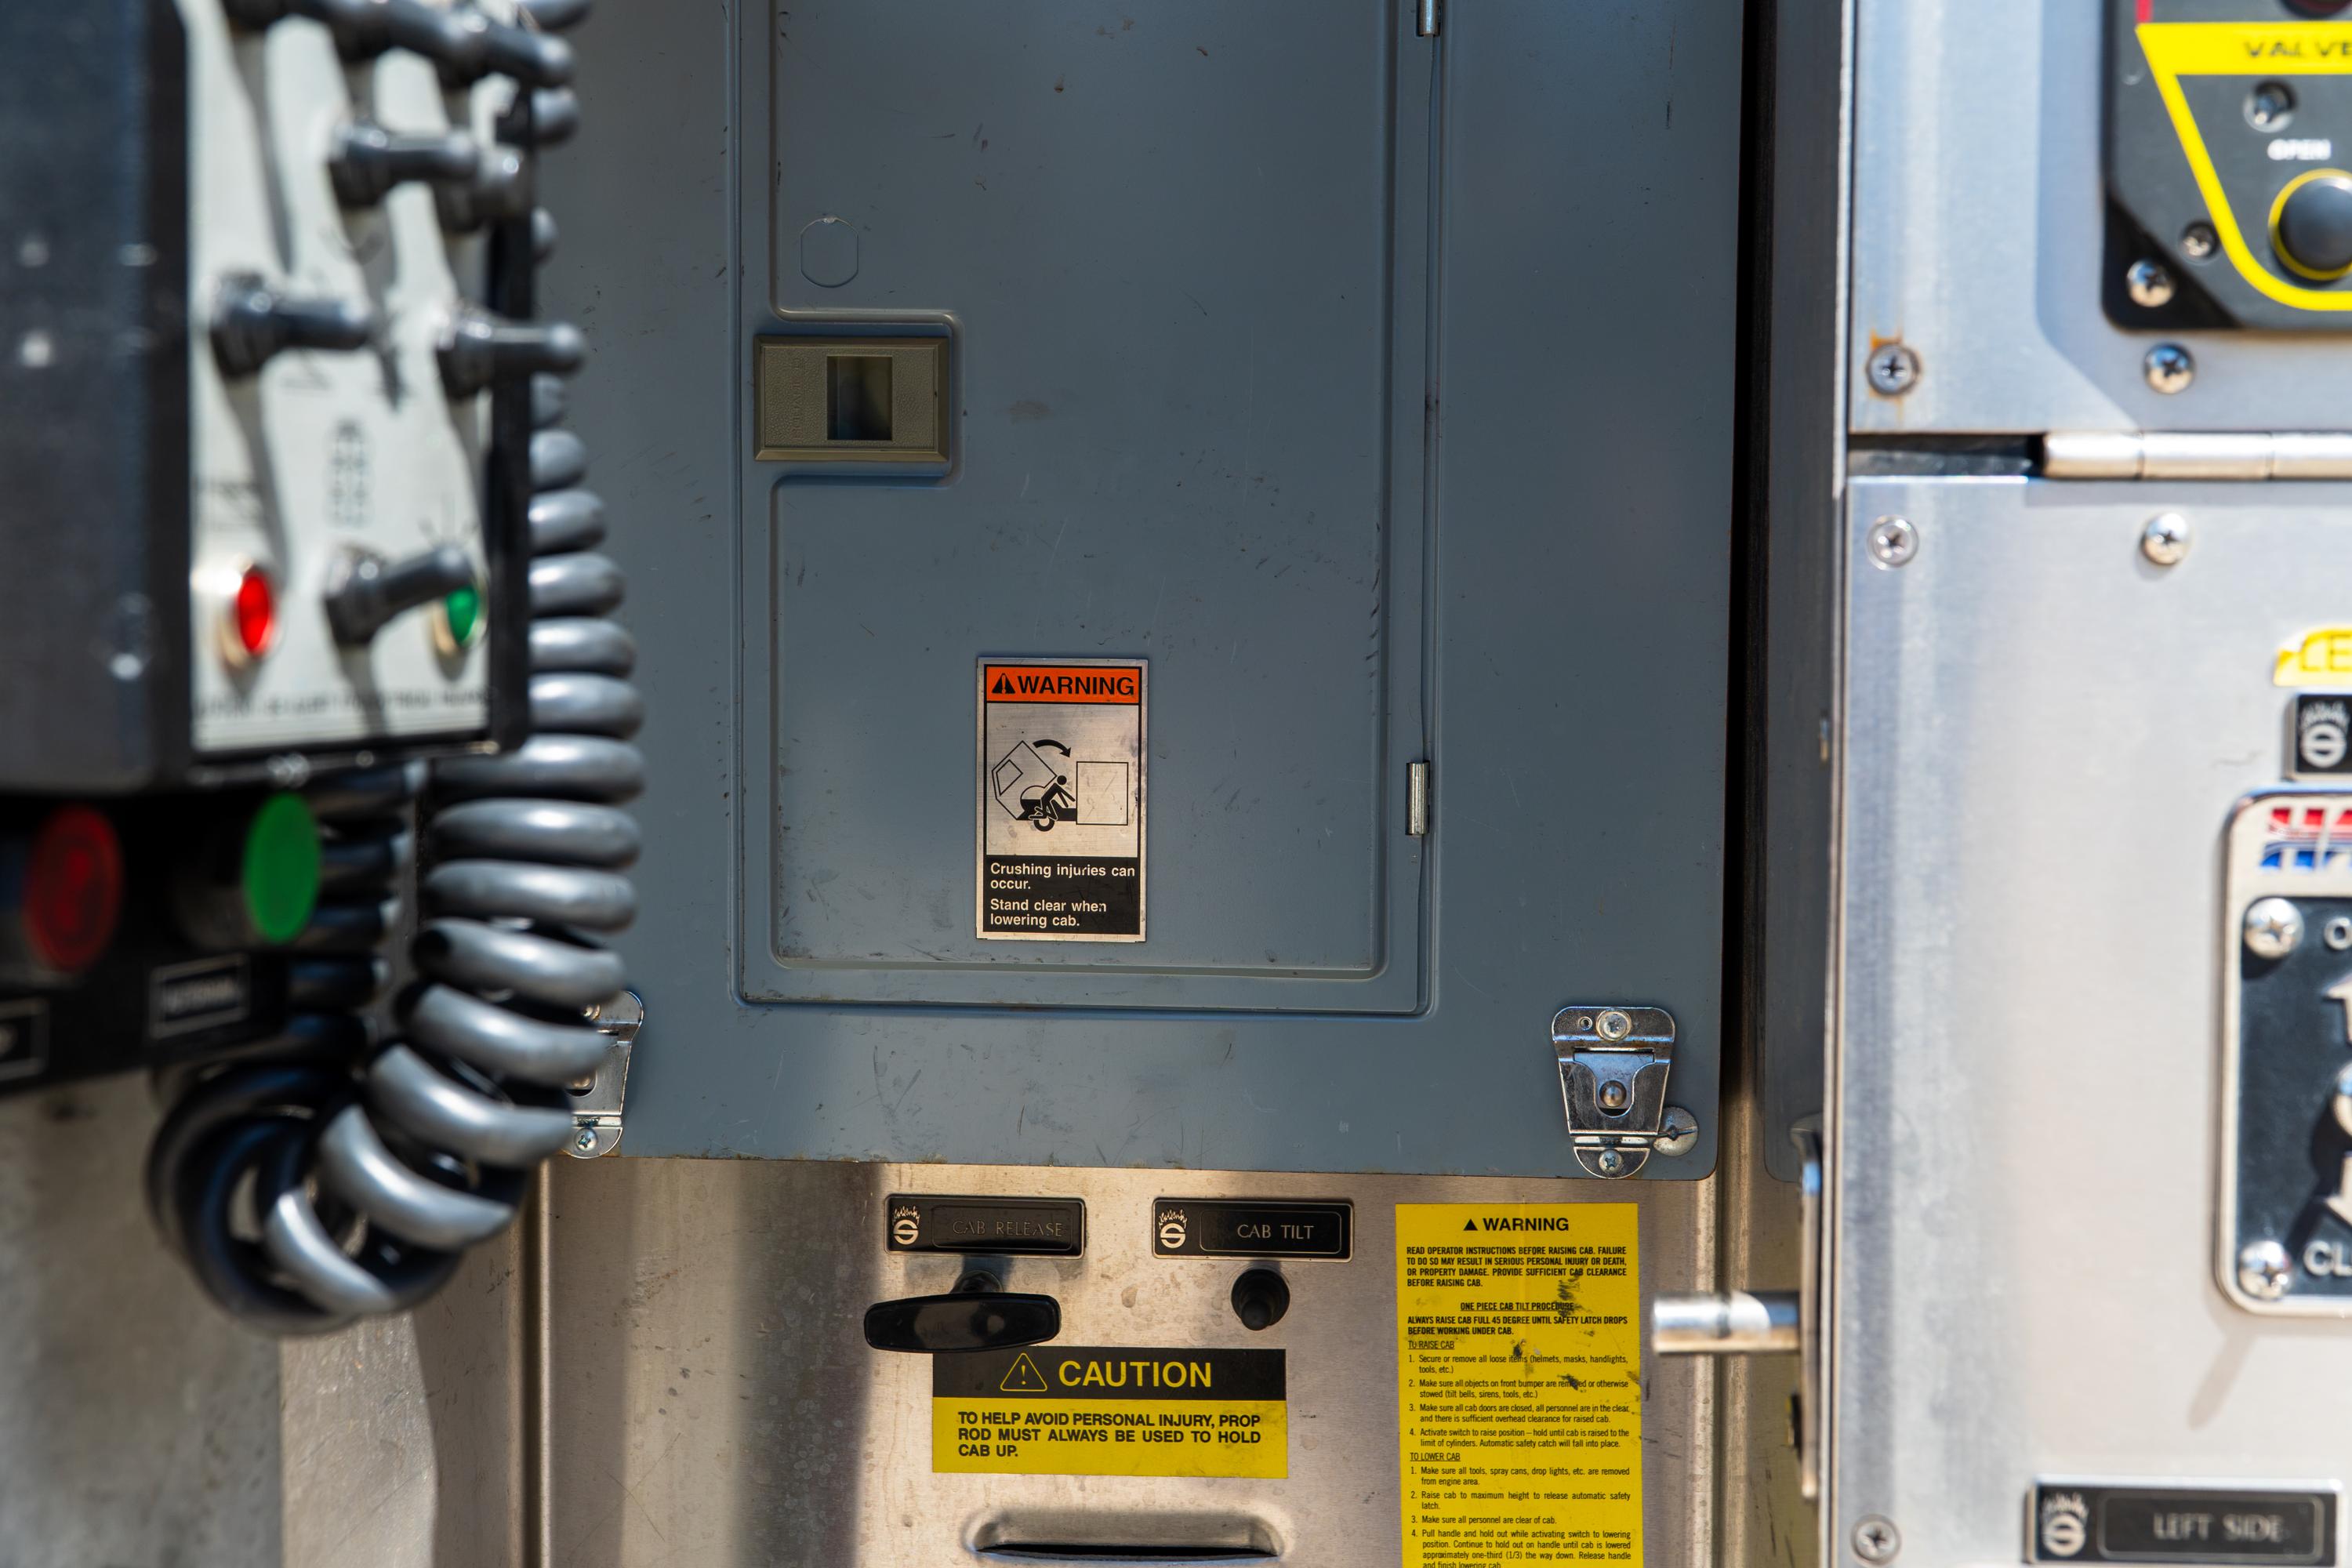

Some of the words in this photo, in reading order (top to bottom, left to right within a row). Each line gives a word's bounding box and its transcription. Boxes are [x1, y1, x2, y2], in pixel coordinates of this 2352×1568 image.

[1017, 675, 1134, 696] WARNING
[990, 862, 1052, 878] Crushing
[1057, 863, 1106, 878] injuries
[1111, 866, 1135, 877] can
[990, 880, 1031, 889] occur.
[990, 898, 1029, 911] Stand
[1034, 899, 1066, 911] clear
[1071, 901, 1107, 912] when
[990, 913, 1047, 928] lowering
[1052, 915, 1080, 926] cab.
[953, 1220, 985, 1235] CAB
[996, 1221, 1063, 1237] RELEASE
[1483, 1218, 1570, 1231] WARNING
[1236, 1224, 1272, 1239] CAB
[1280, 1225, 1315, 1240] TILT
[1602, 1258, 1627, 1266] DEATH,
[1408, 1327, 1436, 1335] BEFORE
[1436, 1327, 1470, 1335] WORKING
[1472, 1327, 1496, 1335] UNDER
[1497, 1327, 1514, 1335] CAB.
[1419, 1355, 1442, 1363] Secure
[1479, 1355, 1487, 1363] all
[1490, 1355, 1507, 1363] loose
[1530, 1355, 1562, 1365] (helmets,
[1563, 1355, 1588, 1364] masks,
[1590, 1355, 1628, 1365] handlights,
[1058, 1360, 1212, 1388] CAUTION
[1445, 1390, 1457, 1399] (tilt
[1459, 1390, 1477, 1399] bells,
[1479, 1390, 1501, 1399] sirens,
[1502, 1390, 1521, 1399] tools,
[1523, 1390, 1538, 1399] etc.)
[958, 1412, 978, 1425] TO
[982, 1412, 1021, 1425] HELP
[1024, 1413, 1069, 1426] AVOID
[1073, 1414, 1155, 1427] PERSONAL
[1159, 1414, 1215, 1429] INJURY,
[1219, 1414, 1261, 1428] PROP
[958, 1428, 991, 1441] ROD
[998, 1428, 1040, 1441] MUST
[1047, 1428, 1109, 1442] ALWAYS
[1115, 1429, 1136, 1442] BE
[1142, 1429, 1184, 1443] USED
[1192, 1430, 1209, 1443] TO
[1218, 1430, 1261, 1443] HOLD
[958, 1443, 990, 1457] CAB
[996, 1444, 1018, 1457] UP.
[1469, 1467, 1487, 1475] tools,
[1531, 1467, 1547, 1476] drop
[1549, 1467, 1570, 1476] lights,
[1438, 1477, 1461, 1486] engine
[1508, 1491, 1530, 1501] height
[1610, 1491, 1631, 1501] safety
[1531, 1530, 1565, 1539] activating
[1602, 1530, 1631, 1539] lowering
